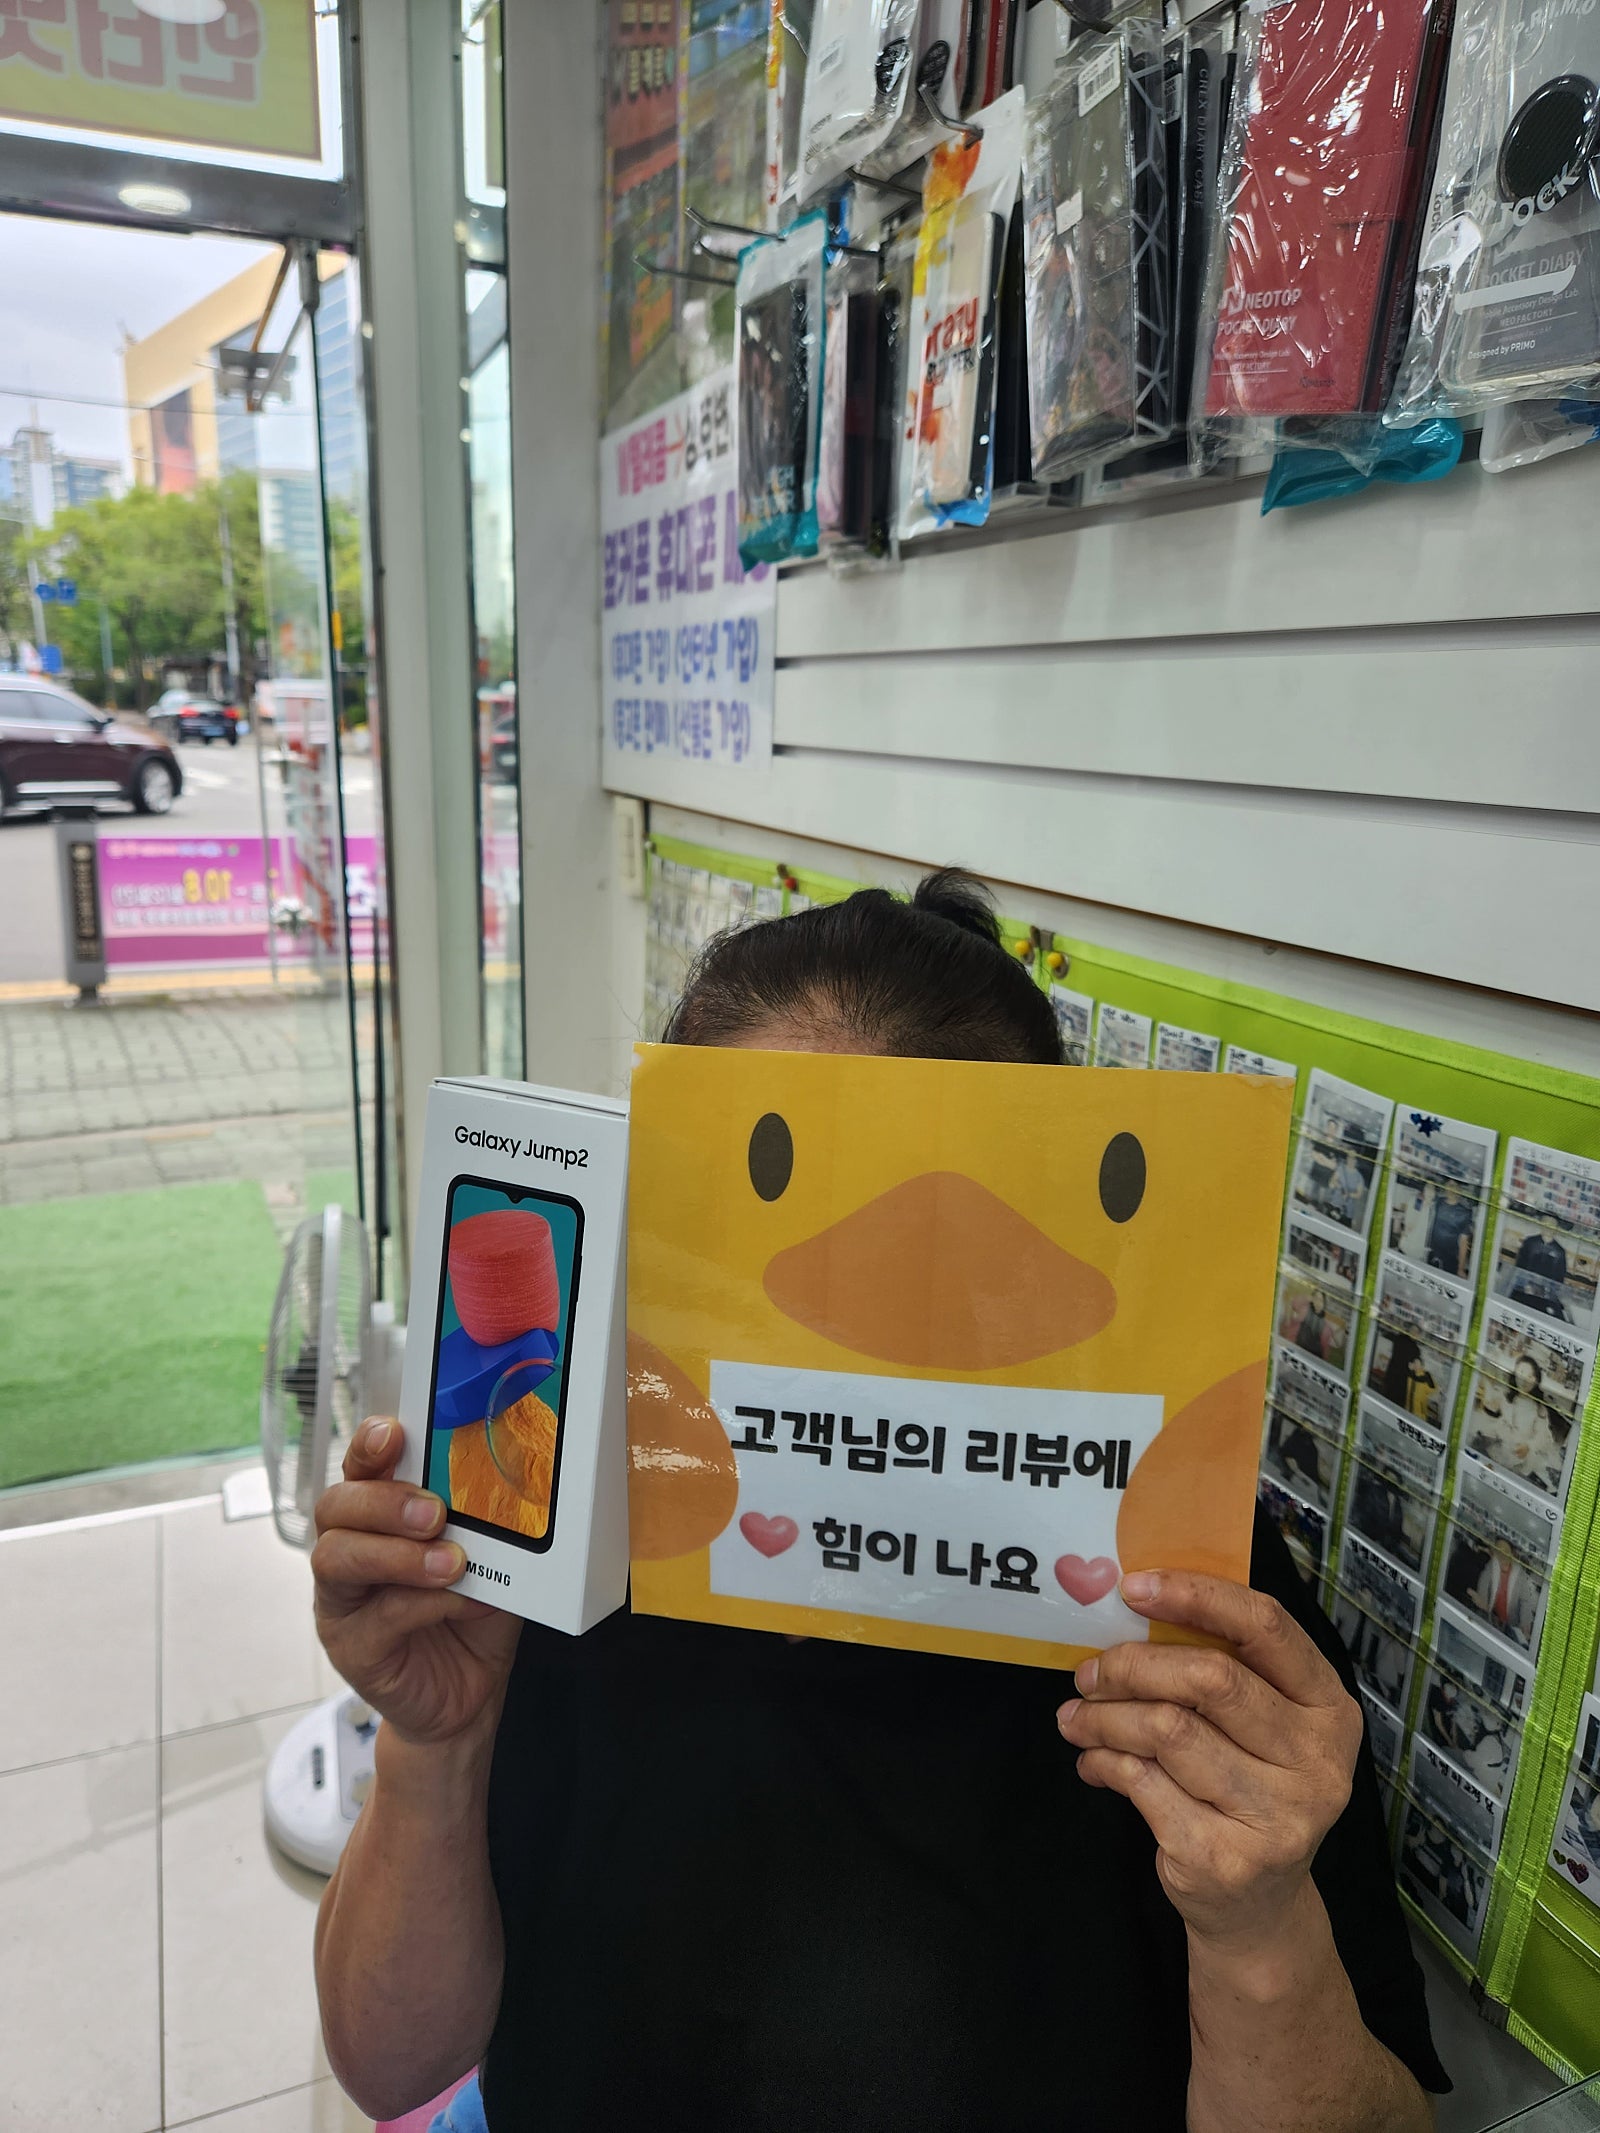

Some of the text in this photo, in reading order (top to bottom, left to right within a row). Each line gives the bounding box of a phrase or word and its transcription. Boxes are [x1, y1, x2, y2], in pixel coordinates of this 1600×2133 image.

[1244, 288, 1302, 311] NEOTOP
[1510, 339, 1536, 353] PRIMO
[454, 1126, 589, 1170] Galaxy Jump2
[731, 1405, 1132, 1490] 고객님의 리뷰에
[812, 1516, 1041, 1595] 힘이 나요
[465, 1560, 511, 1587] MSUNG
